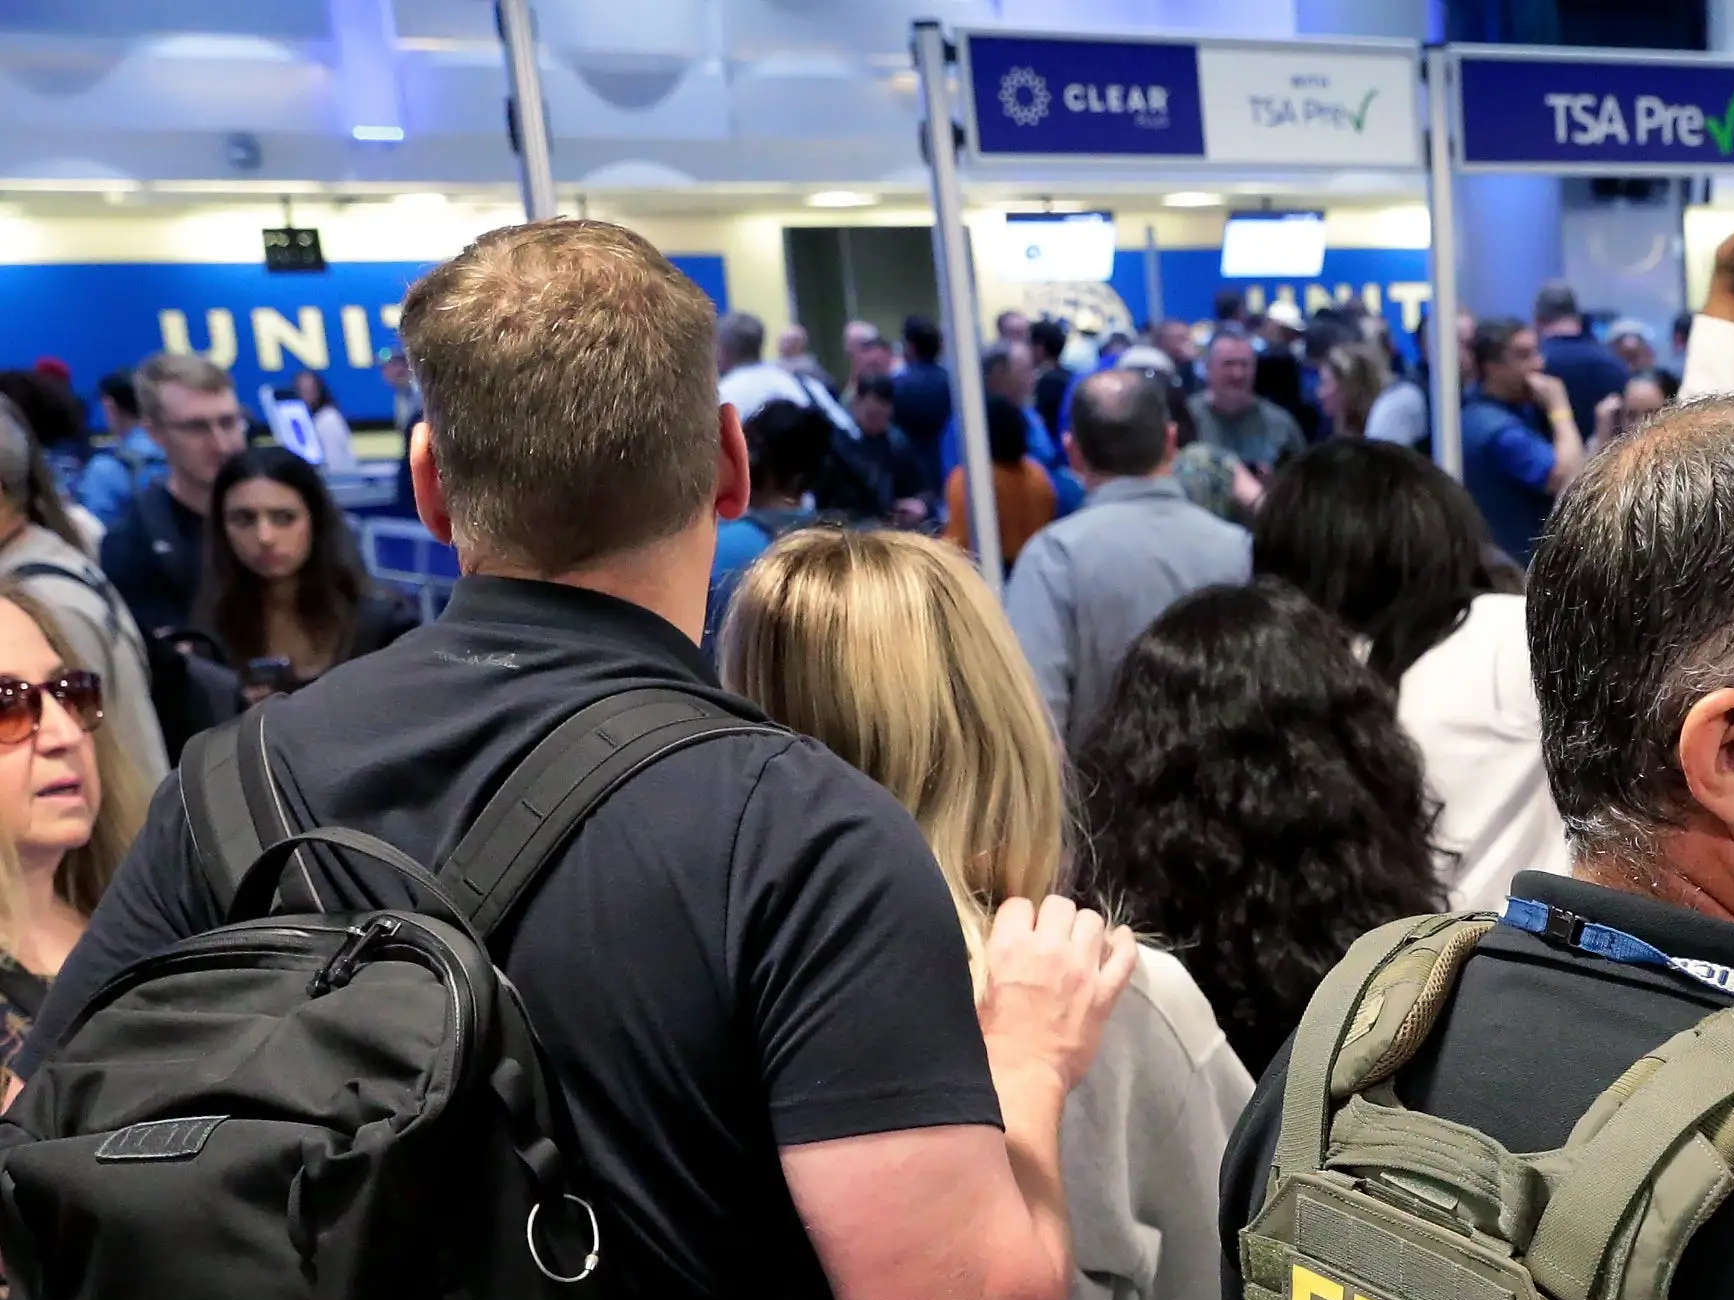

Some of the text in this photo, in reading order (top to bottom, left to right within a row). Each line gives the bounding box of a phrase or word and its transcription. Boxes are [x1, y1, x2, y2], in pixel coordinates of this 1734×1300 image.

[1063, 82, 1169, 114] CLEAR
[1248, 95, 1298, 127] TSA
[1544, 93, 1705, 147] TSA Pre
[158, 304, 402, 372] UNI
